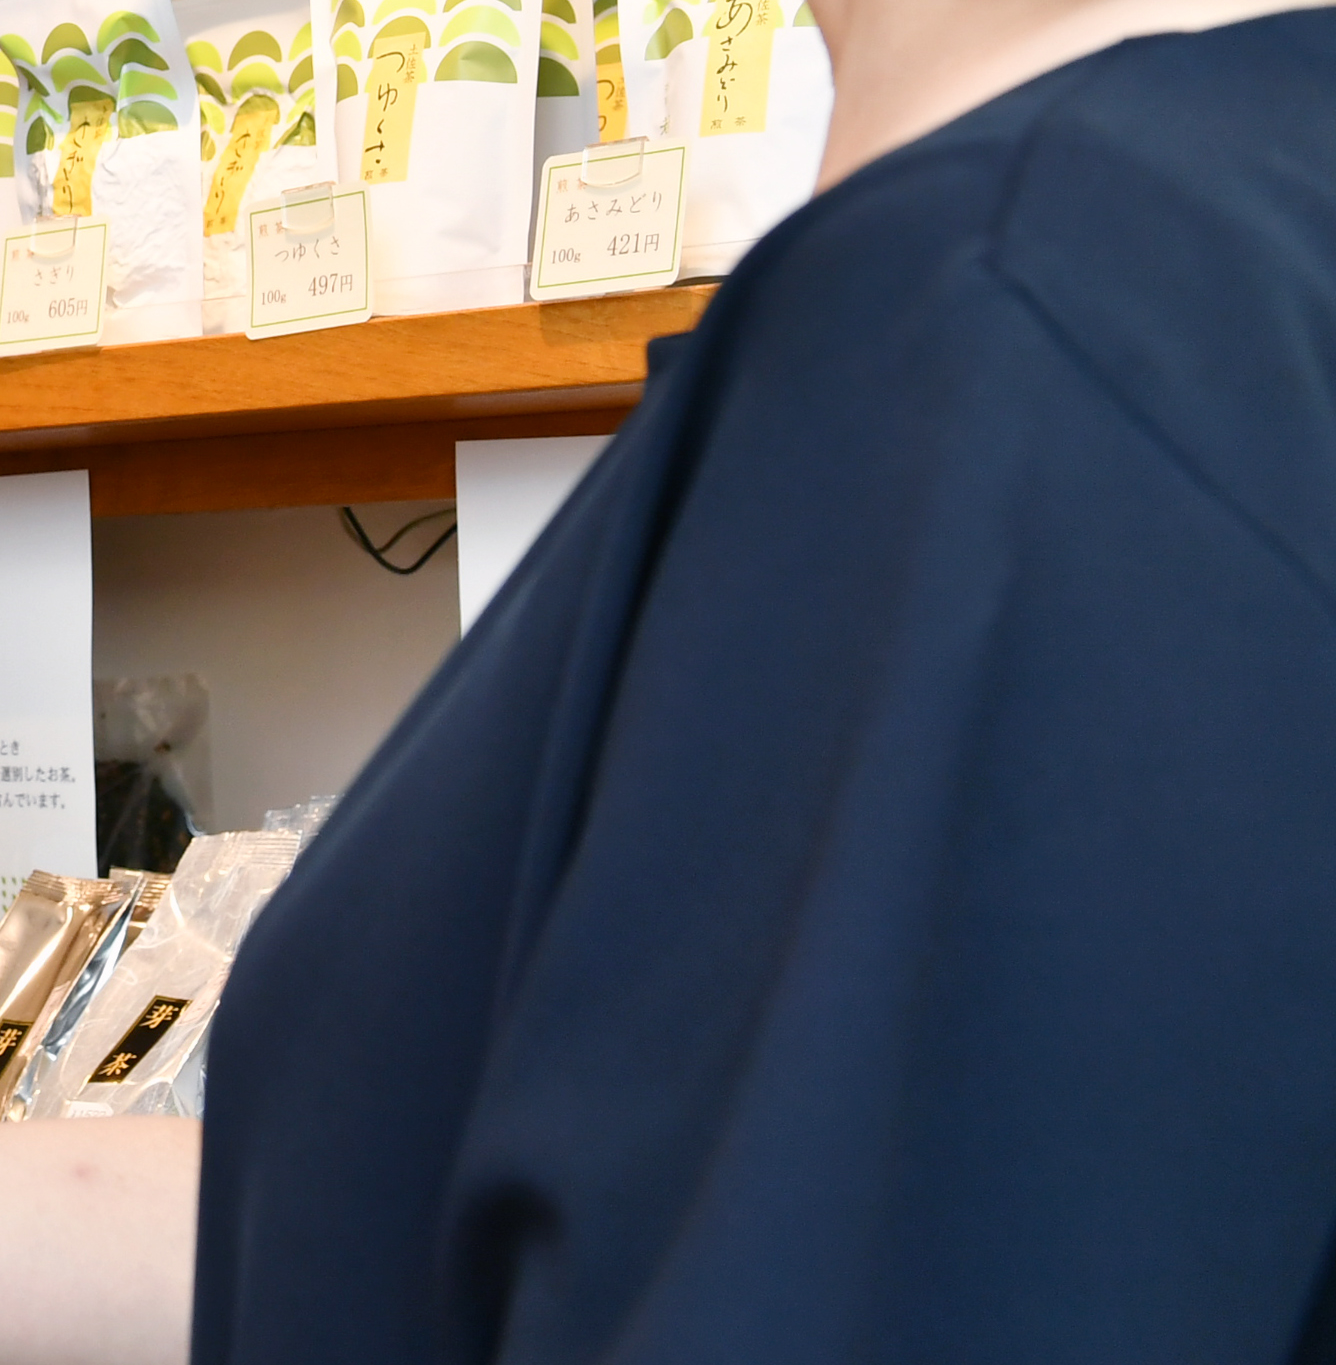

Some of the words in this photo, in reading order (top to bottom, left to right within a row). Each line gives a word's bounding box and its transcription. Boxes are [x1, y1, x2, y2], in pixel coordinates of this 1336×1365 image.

[364, 51, 406, 165] つゆくさ
[564, 191, 663, 224] あさみどり
[274, 236, 340, 263] つゆくさ
[551, 247, 582, 265] 100g
[606, 232, 660, 257] 421円
[34, 265, 75, 287] さぎり
[261, 289, 287, 306] 100g
[308, 273, 354, 297] 497円
[48, 297, 89, 319] 605円
[98, 1003, 180, 1077] 芽茶
